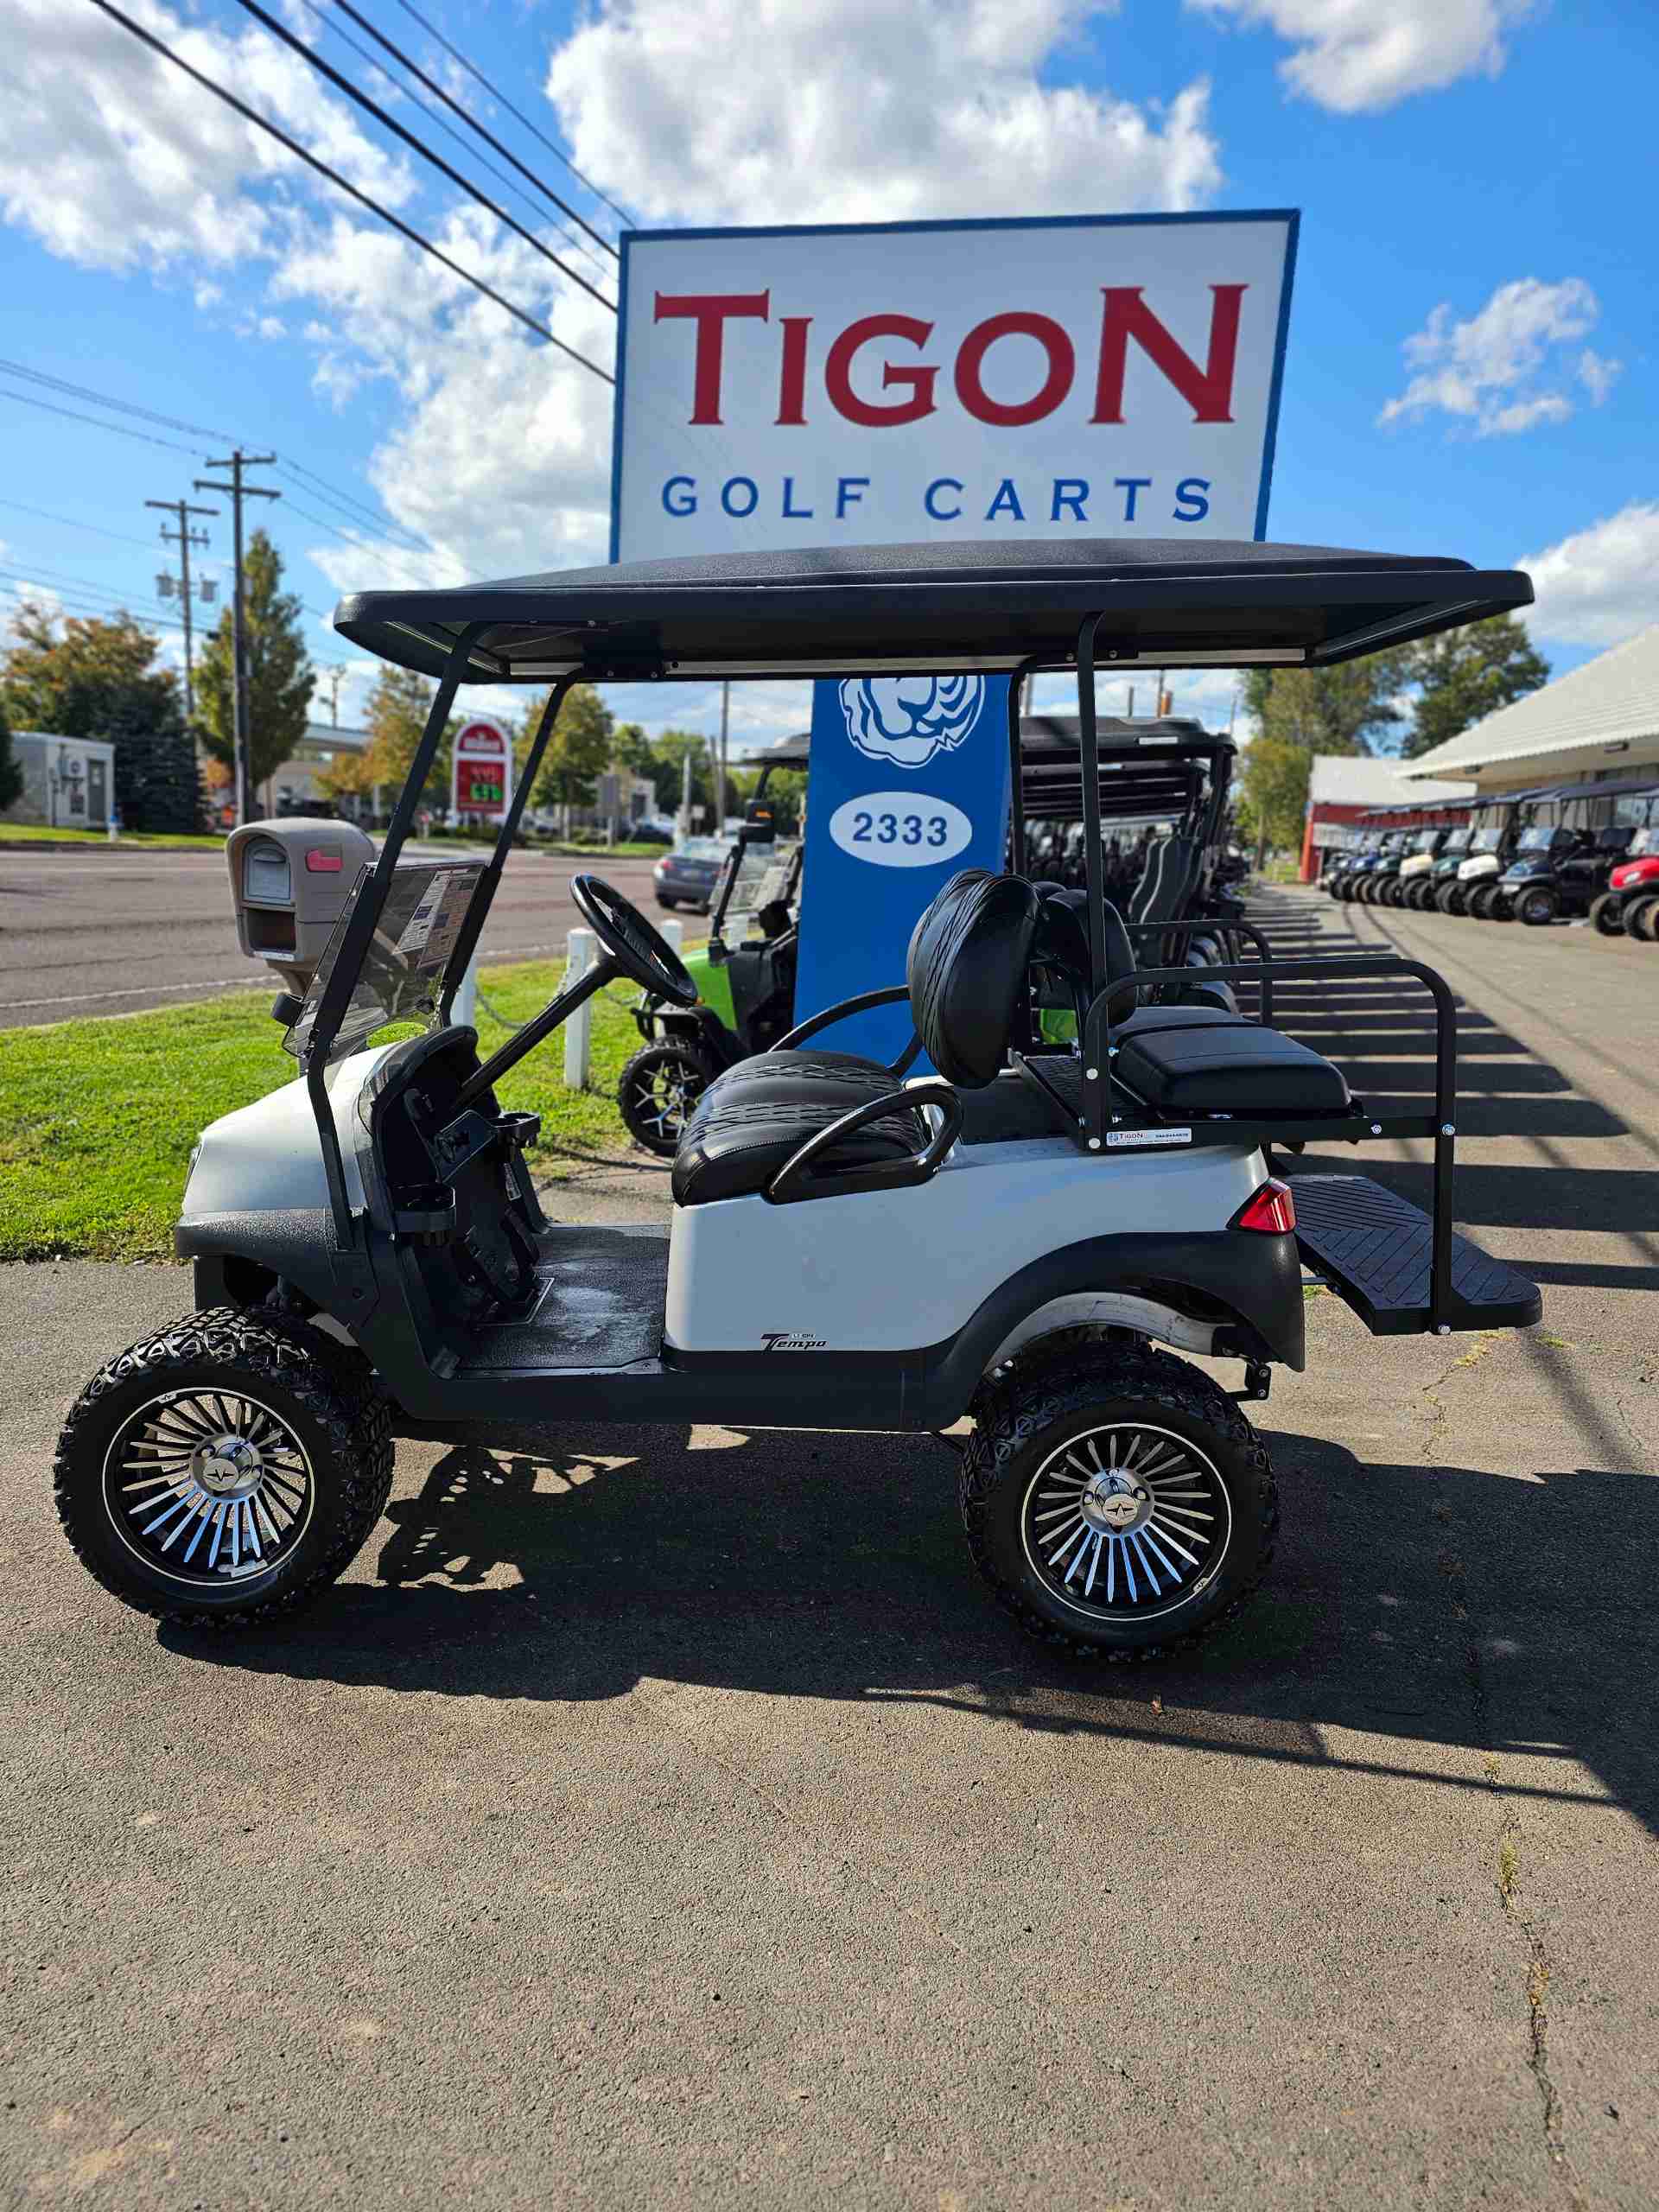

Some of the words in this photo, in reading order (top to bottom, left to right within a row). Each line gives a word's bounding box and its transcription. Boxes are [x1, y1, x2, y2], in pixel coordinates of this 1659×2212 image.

[654, 284, 1249, 428] TIGON
[662, 476, 870, 518] GOLF
[924, 478, 1211, 522] CARTS
[853, 811, 948, 847] 2333
[760, 1333, 827, 1351] Tempo
